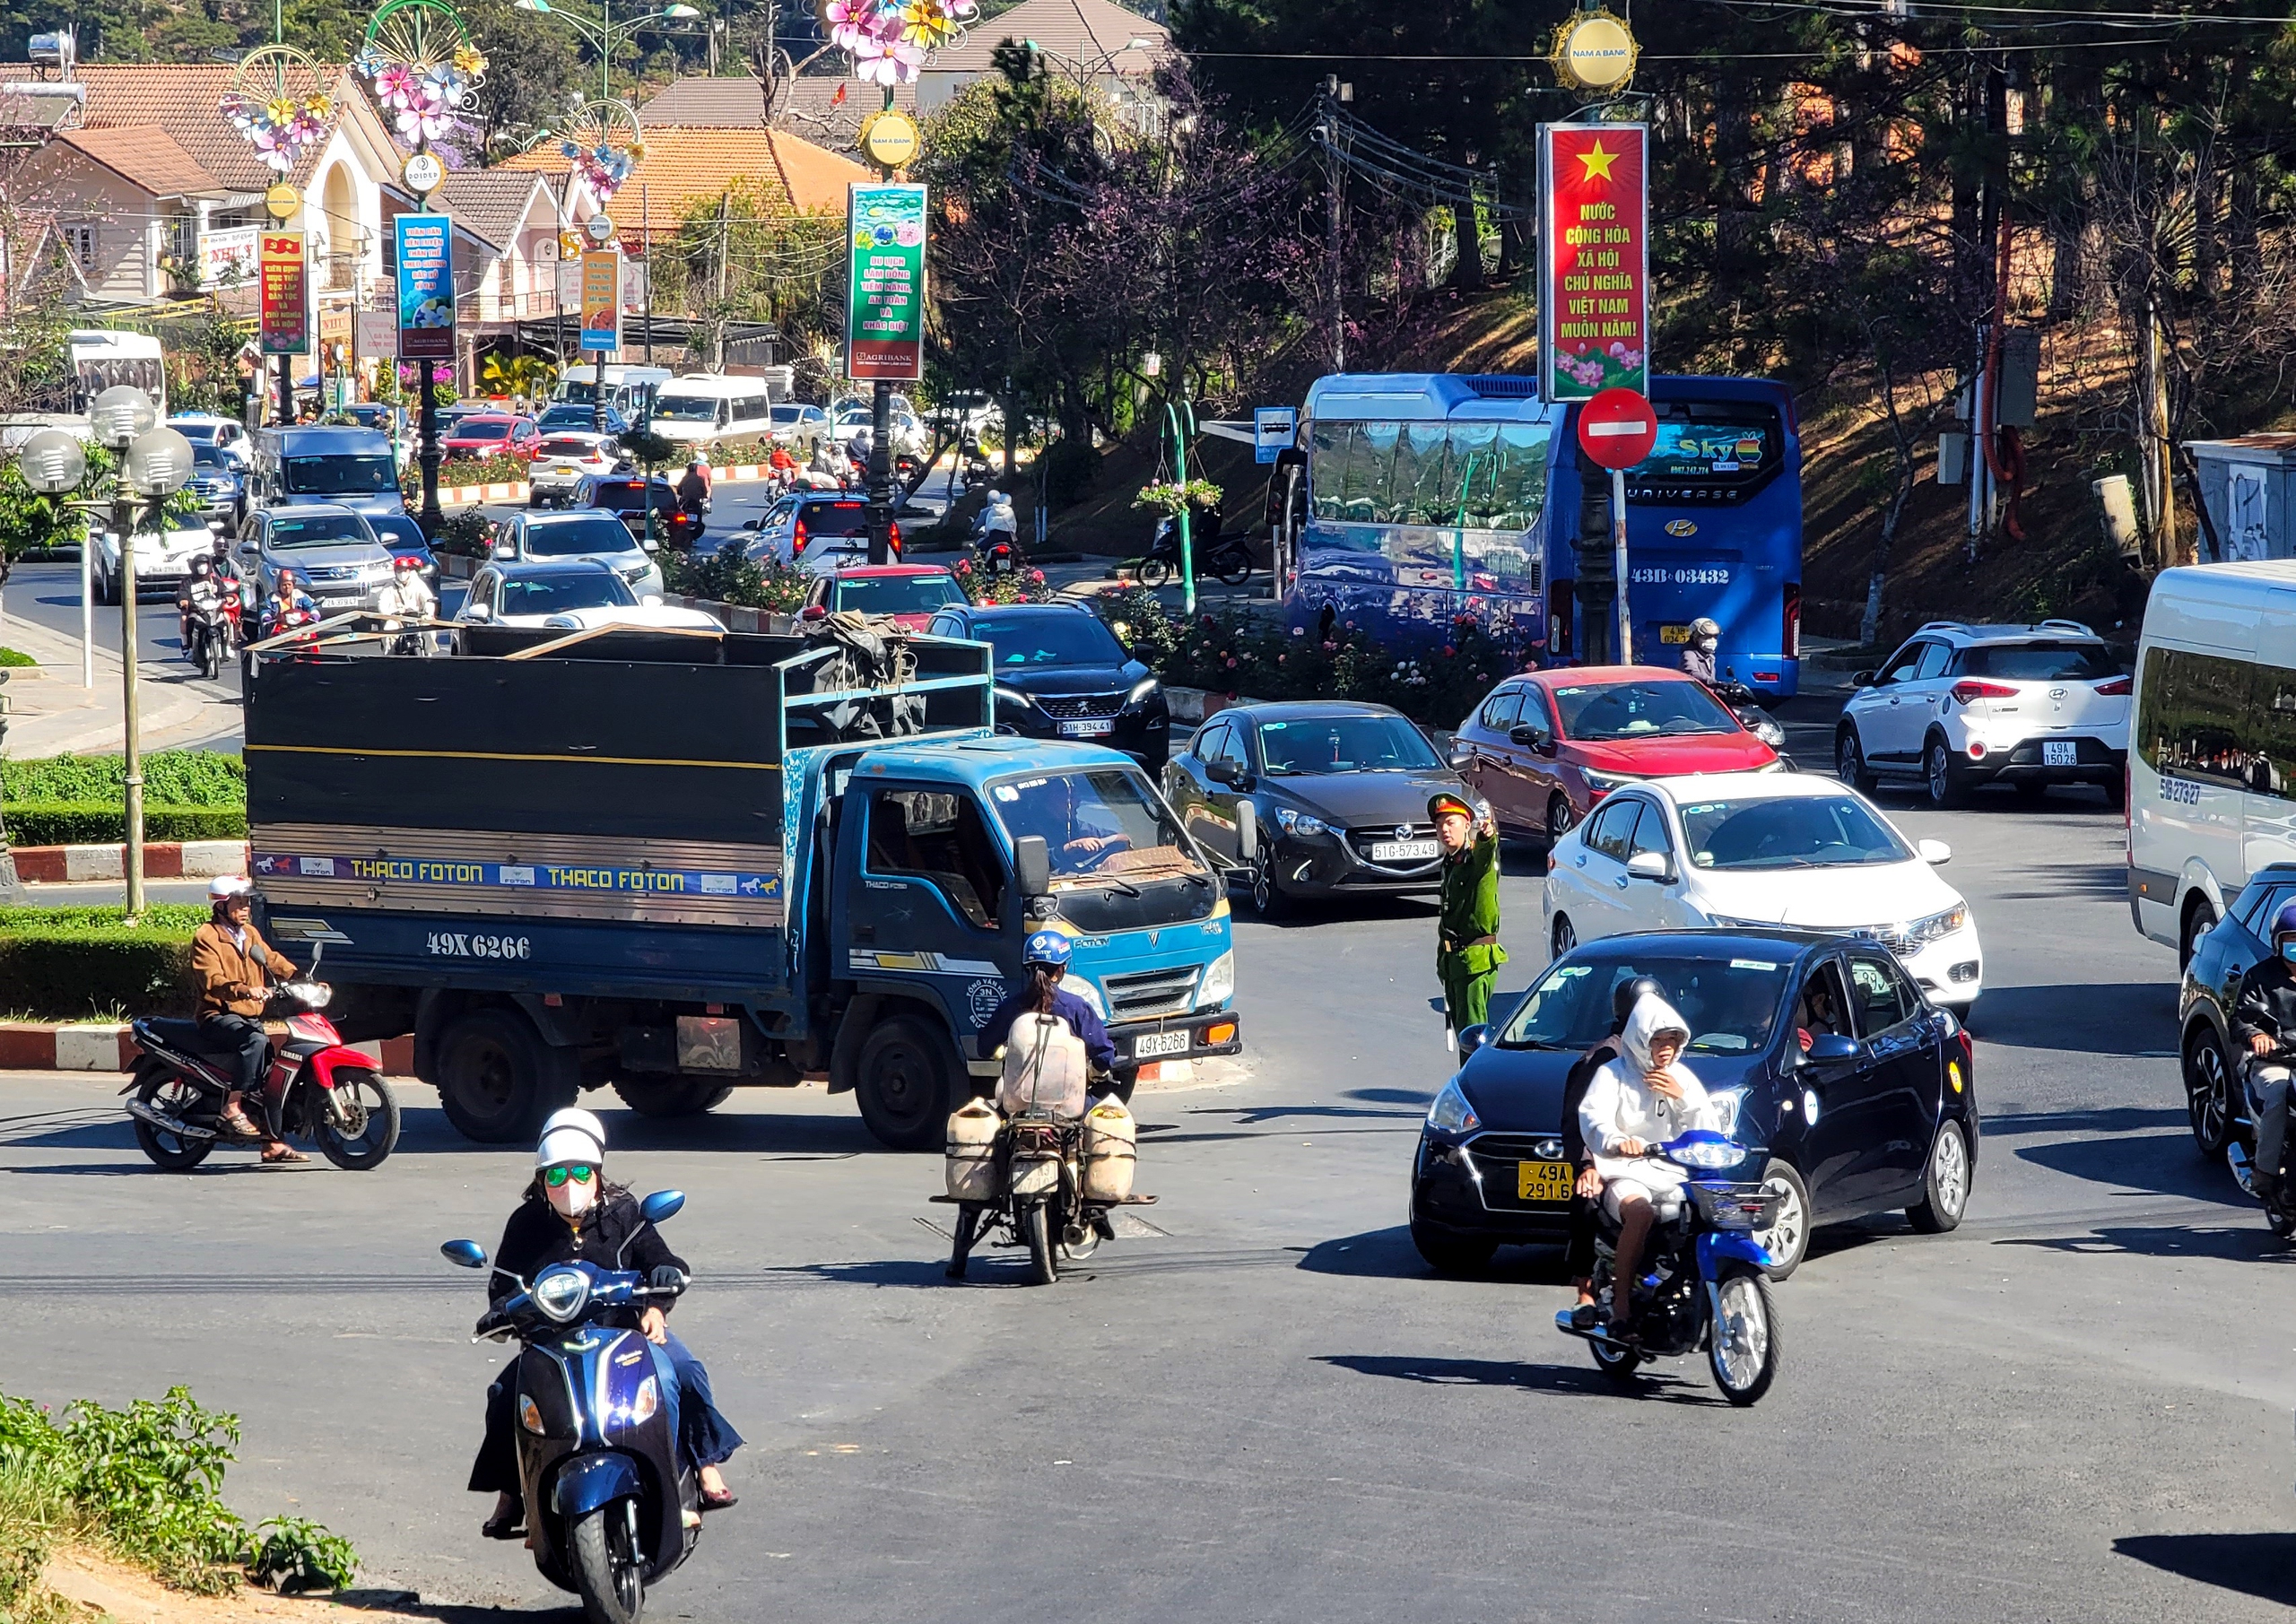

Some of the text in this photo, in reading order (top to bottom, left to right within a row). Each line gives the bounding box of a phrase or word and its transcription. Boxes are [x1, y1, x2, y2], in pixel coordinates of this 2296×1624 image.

[1572, 49, 1594, 57] NAM
[1603, 48, 1627, 56] BANK
[1579, 201, 1616, 221] NƯỚC
[1565, 224, 1631, 248] CỘNG HÒA
[870, 256, 906, 267] DU LỊCH
[1577, 248, 1620, 270] XÃ HỘI
[864, 267, 910, 280] LÂM ĐỒNG
[1564, 271, 1633, 291] CHỦ NGHĨA
[868, 293, 908, 306] AN TOÀN
[1568, 296, 1629, 317] VIỆT NAM
[880, 307, 892, 317] VÀ
[863, 320, 909, 333] KHÁC BIỆT
[1561, 318, 1637, 338] MUÔN NĂM!
[1679, 439, 1734, 462] Sky
[1631, 568, 1729, 584] 43B 03432
[1062, 722, 1109, 732] 51H-394.41
[2051, 743, 2069, 753] 49A
[1375, 844, 1436, 858] 51G-573.49
[351, 860, 483, 882] THACO FOTON
[548, 868, 684, 891] THACO FOTON
[426, 932, 531, 960] 49X 6266
[1139, 1033, 1186, 1055] 49X-6266
[280, 1049, 303, 1062] YAMAHA
[1538, 1165, 1568, 1182] 49A
[1526, 1183, 1571, 1199] 291.6
